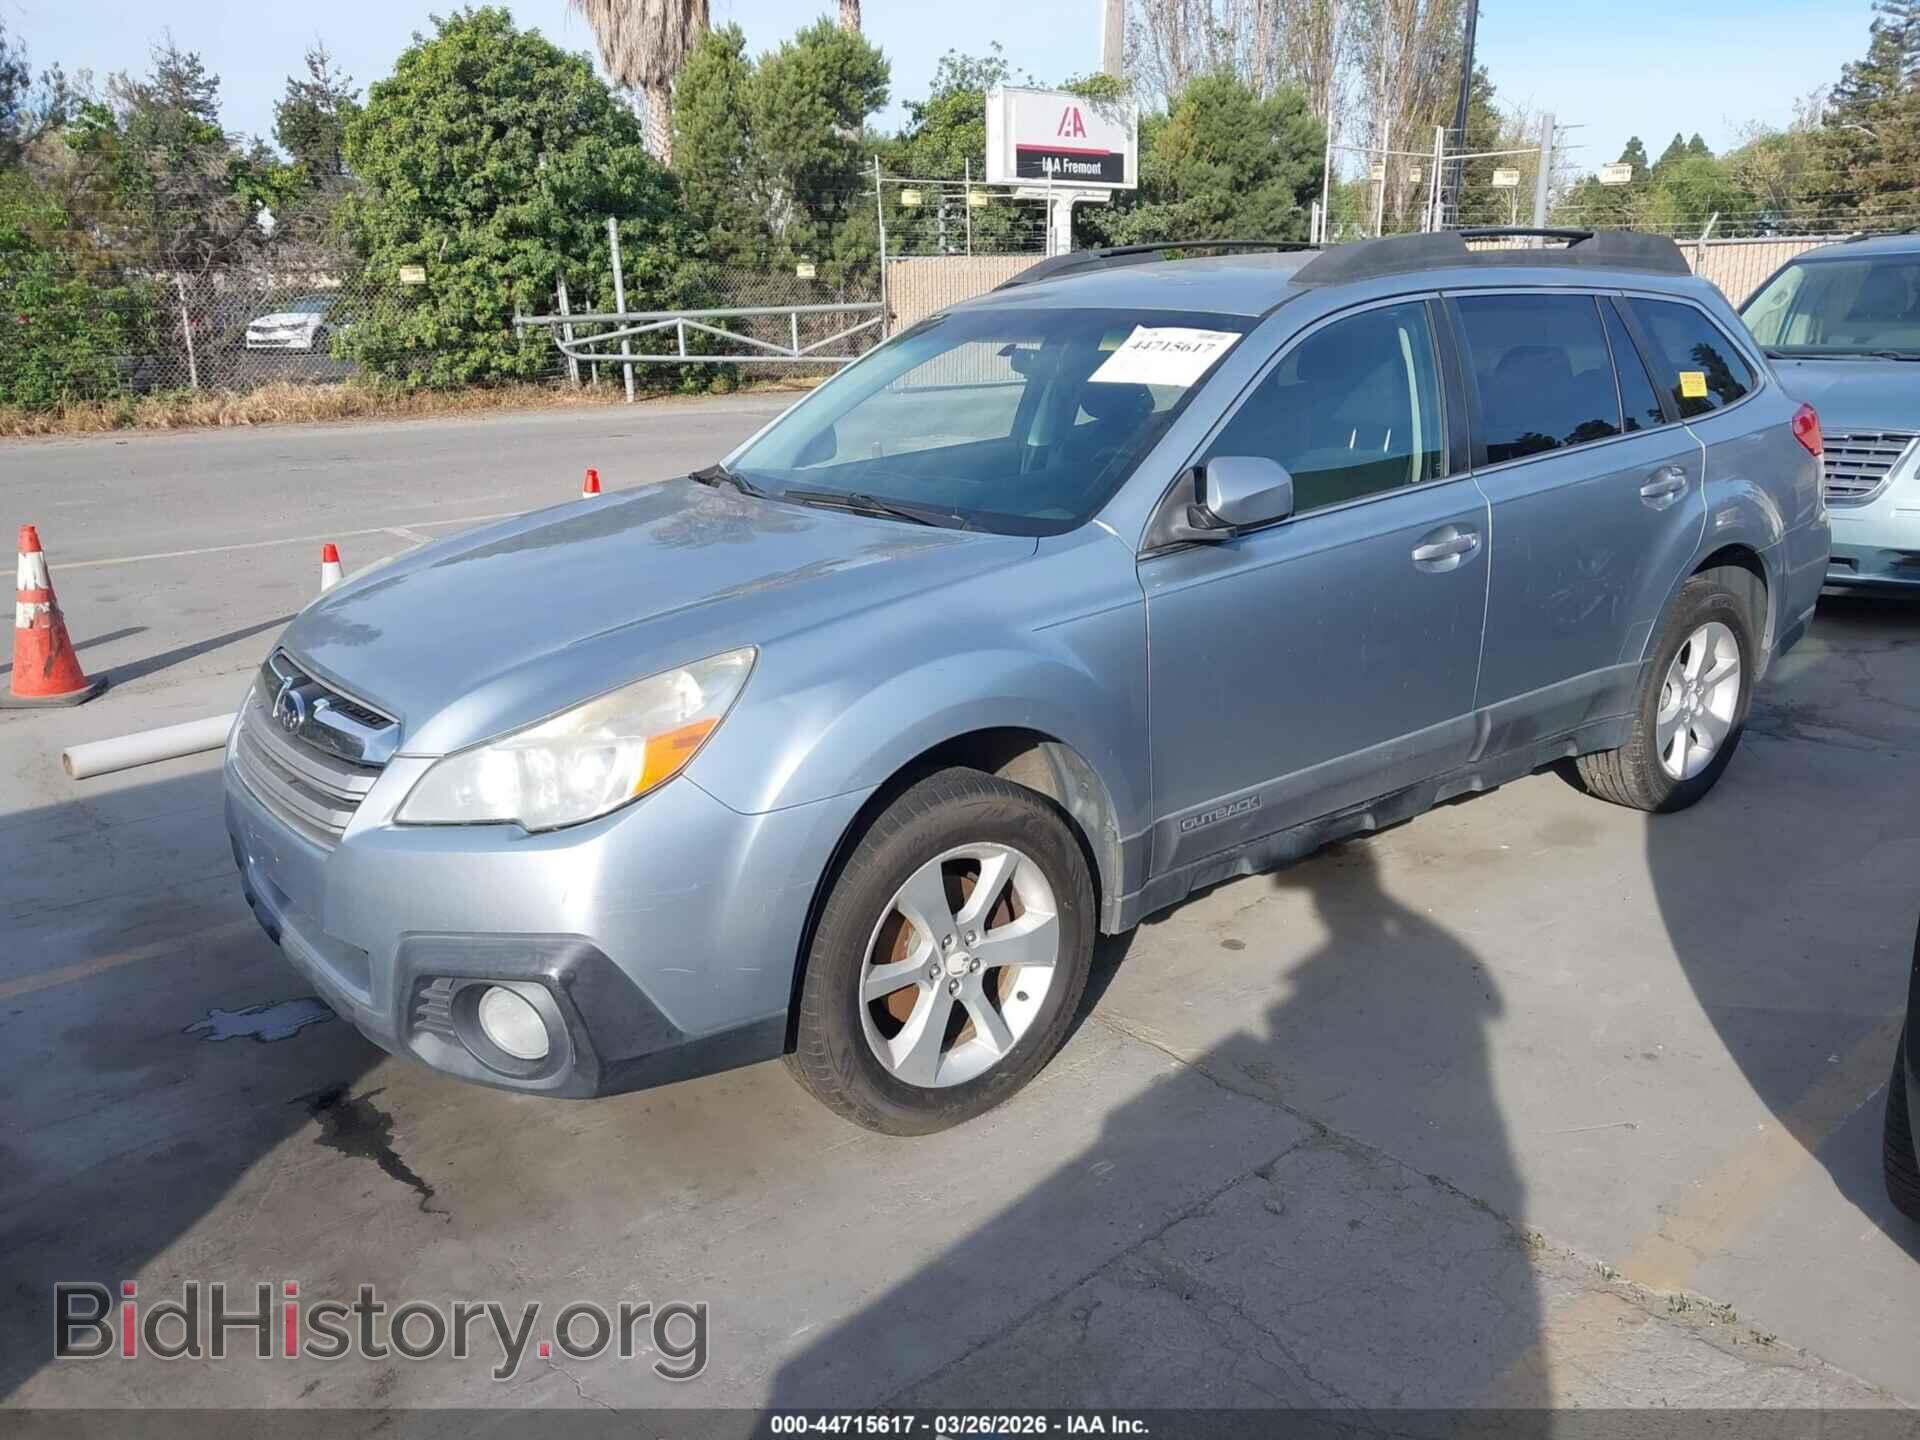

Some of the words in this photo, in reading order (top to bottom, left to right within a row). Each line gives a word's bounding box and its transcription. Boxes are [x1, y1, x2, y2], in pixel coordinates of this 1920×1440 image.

[1042, 156, 1061, 173] IAA
[1063, 158, 1102, 175] Fremont
[1128, 340, 1216, 353] 44715617
[1181, 795, 1262, 830] OUTBACK
